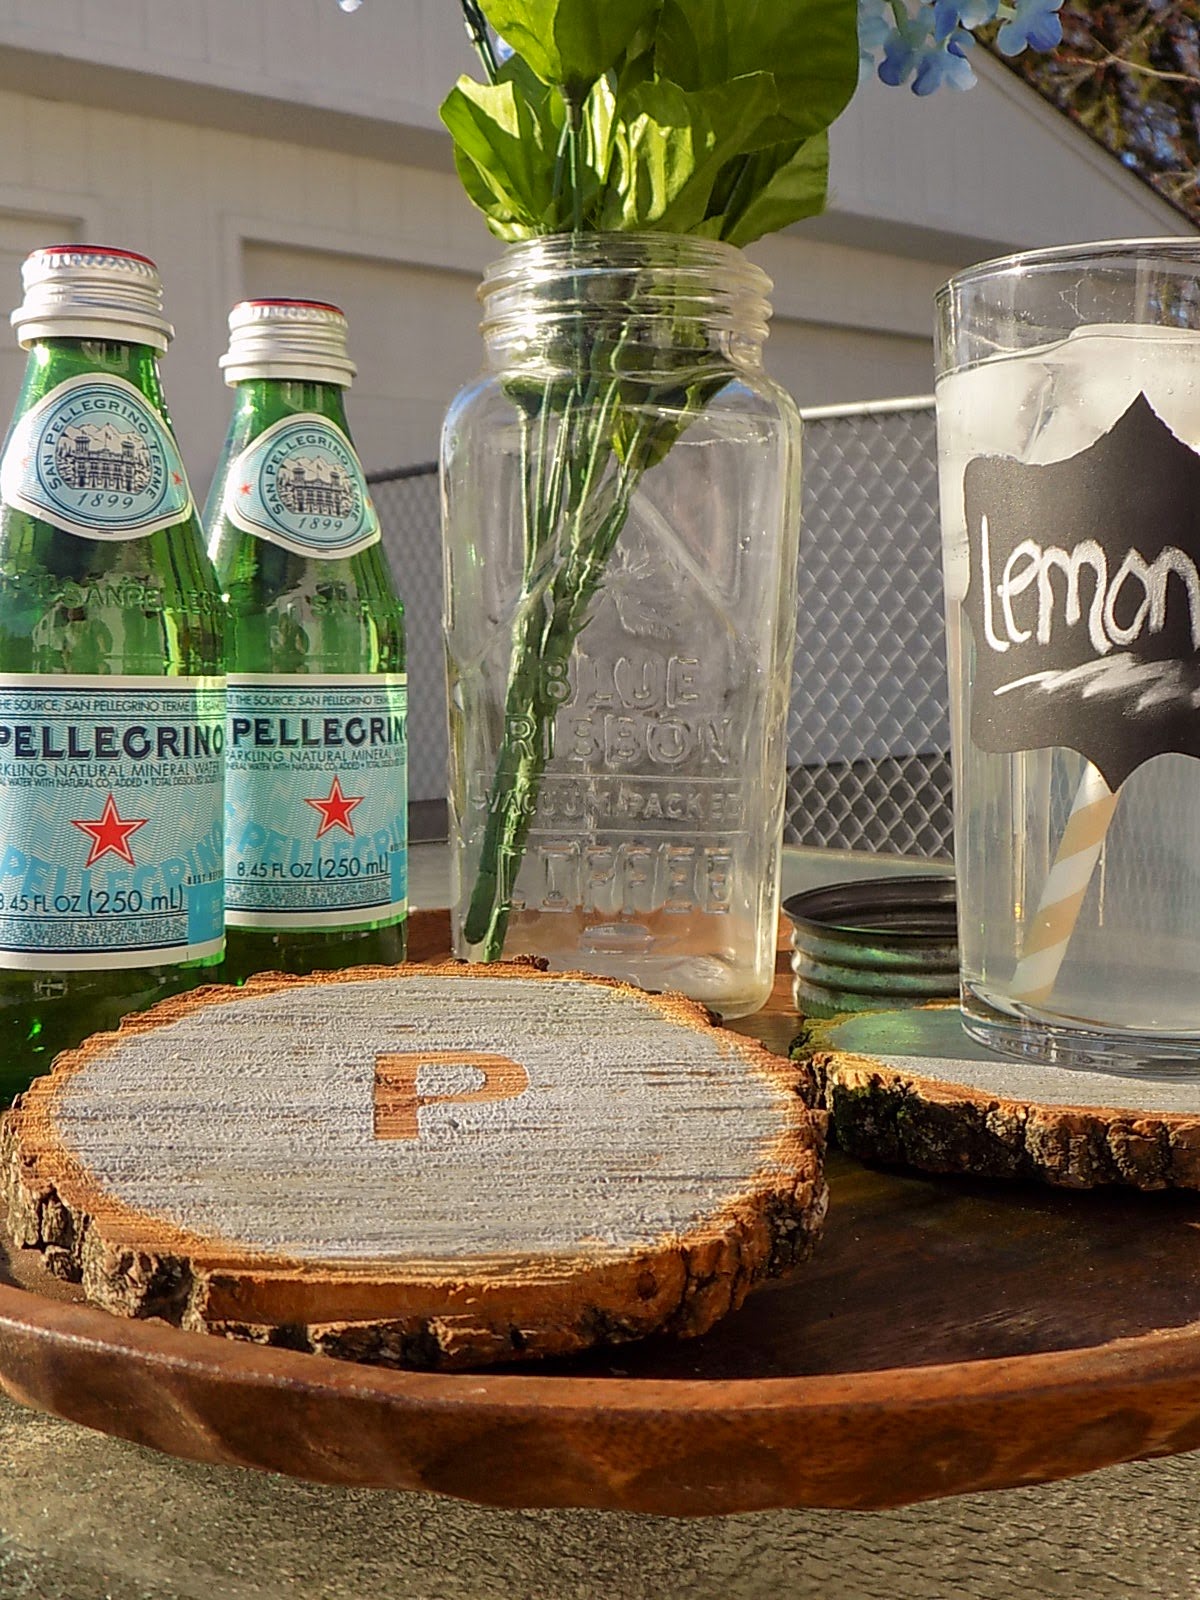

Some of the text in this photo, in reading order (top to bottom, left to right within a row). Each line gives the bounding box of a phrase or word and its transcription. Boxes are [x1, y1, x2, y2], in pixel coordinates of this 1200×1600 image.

[43, 400, 163, 500] SAN PELLEGRINO TERME
[266, 434, 349, 476] PELLEGRINO
[77, 492, 133, 509] 1899
[265, 483, 285, 515] SAN
[299, 517, 343, 532] 1899
[980, 513, 1200, 656] lemon
[538, 656, 701, 709] BLUE
[15, 700, 60, 712] SOURCE,
[65, 701, 90, 712] SAN
[94, 701, 159, 712] PELLEGRINO
[253, 695, 296, 706] SOURCE,
[299, 696, 321, 706] SAN
[322, 696, 372, 706] PELLEGRINO
[290, 750, 347, 763] NATURAL
[351, 748, 391, 761] MINERAL
[504, 714, 731, 768] RIBBON
[55, 764, 124, 777] NATURAL
[131, 763, 190, 777] MINERAL
[237, 861, 267, 877] 8.45
[272, 863, 285, 878] FL
[290, 862, 313, 878] OZ
[318, 856, 360, 881] (250
[366, 850, 388, 875] mL)
[34, 896, 49, 912] FL
[54, 896, 82, 912] OZ
[88, 889, 142, 917] (250
[151, 885, 183, 911] mL)
[374, 1051, 530, 1139] P
